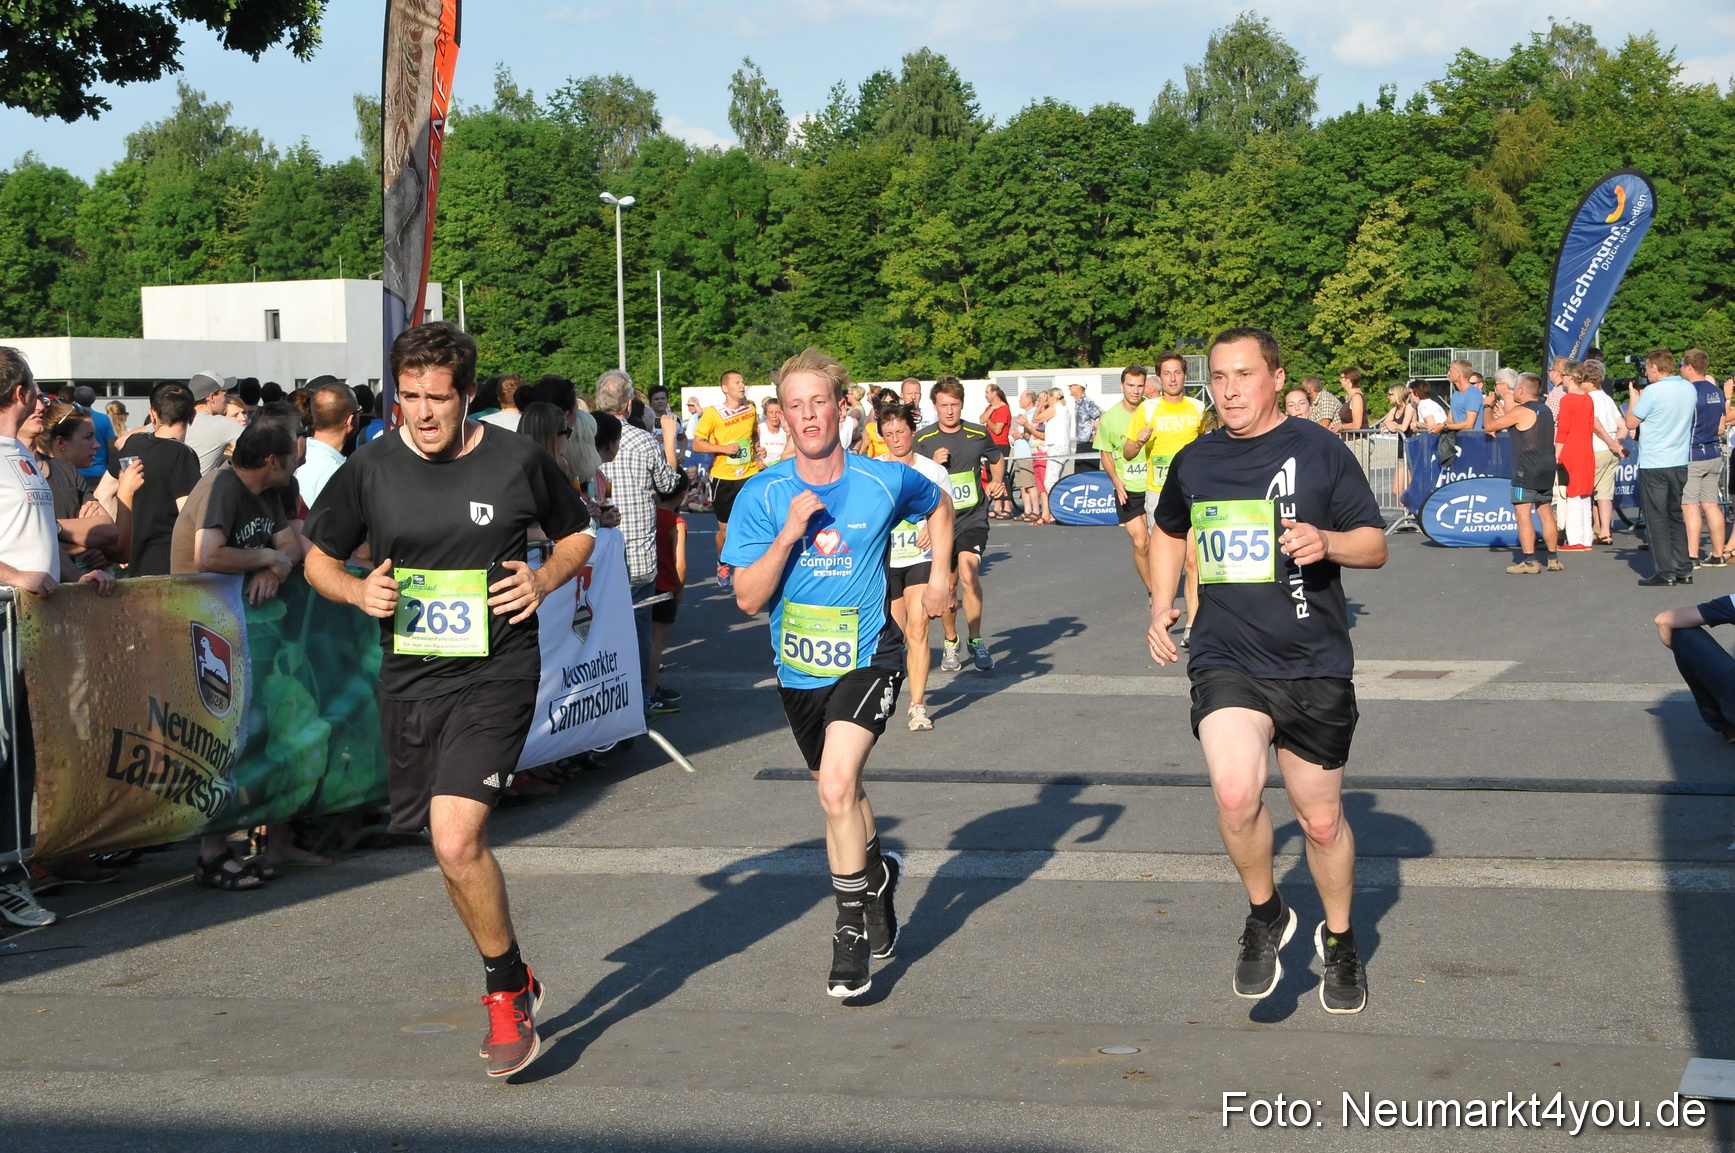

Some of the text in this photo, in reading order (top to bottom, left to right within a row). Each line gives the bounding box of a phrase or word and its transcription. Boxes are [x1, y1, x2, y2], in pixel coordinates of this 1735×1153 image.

[1554, 225, 1626, 332] Frischmann
[1155, 421, 1185, 431] RUN
[800, 555, 853, 570] camping
[1197, 529, 1270, 563] 1055
[406, 599, 471, 634] 263
[783, 632, 852, 668] 5038
[560, 650, 618, 692] Neumarkter
[548, 677, 629, 735] Lammsbräu
